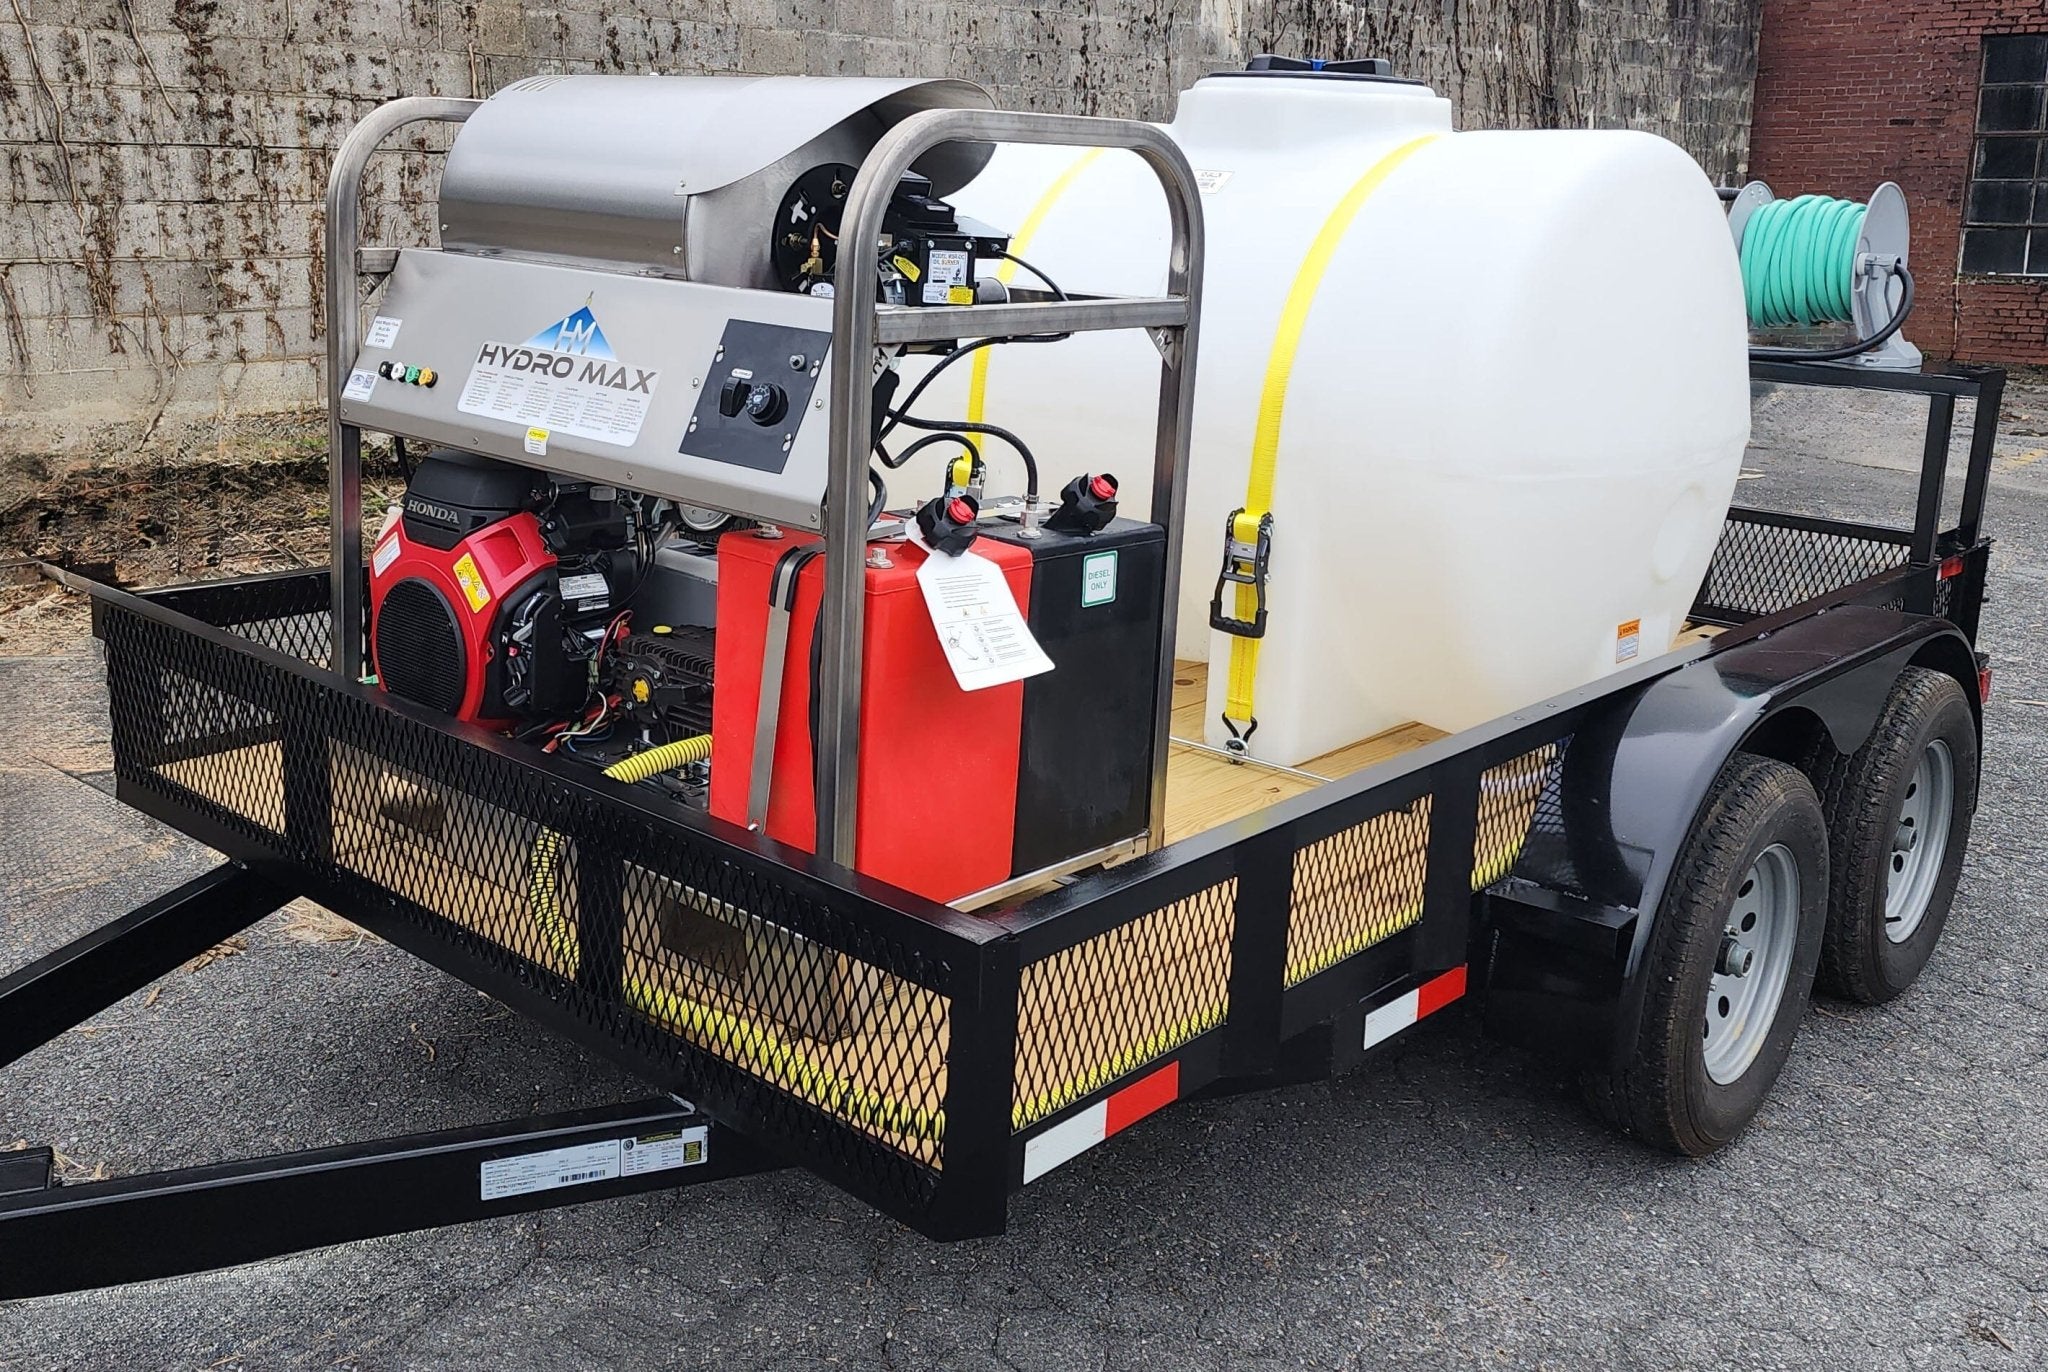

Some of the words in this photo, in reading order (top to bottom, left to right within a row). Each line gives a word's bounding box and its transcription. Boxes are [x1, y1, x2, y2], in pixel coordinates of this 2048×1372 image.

[553, 317, 597, 356] HM
[477, 344, 574, 378] HYDRO
[578, 361, 657, 394] MAX
[406, 499, 460, 524] HONDA
[1088, 569, 1111, 580] DIESEL
[1091, 581, 1108, 591] ONLY
